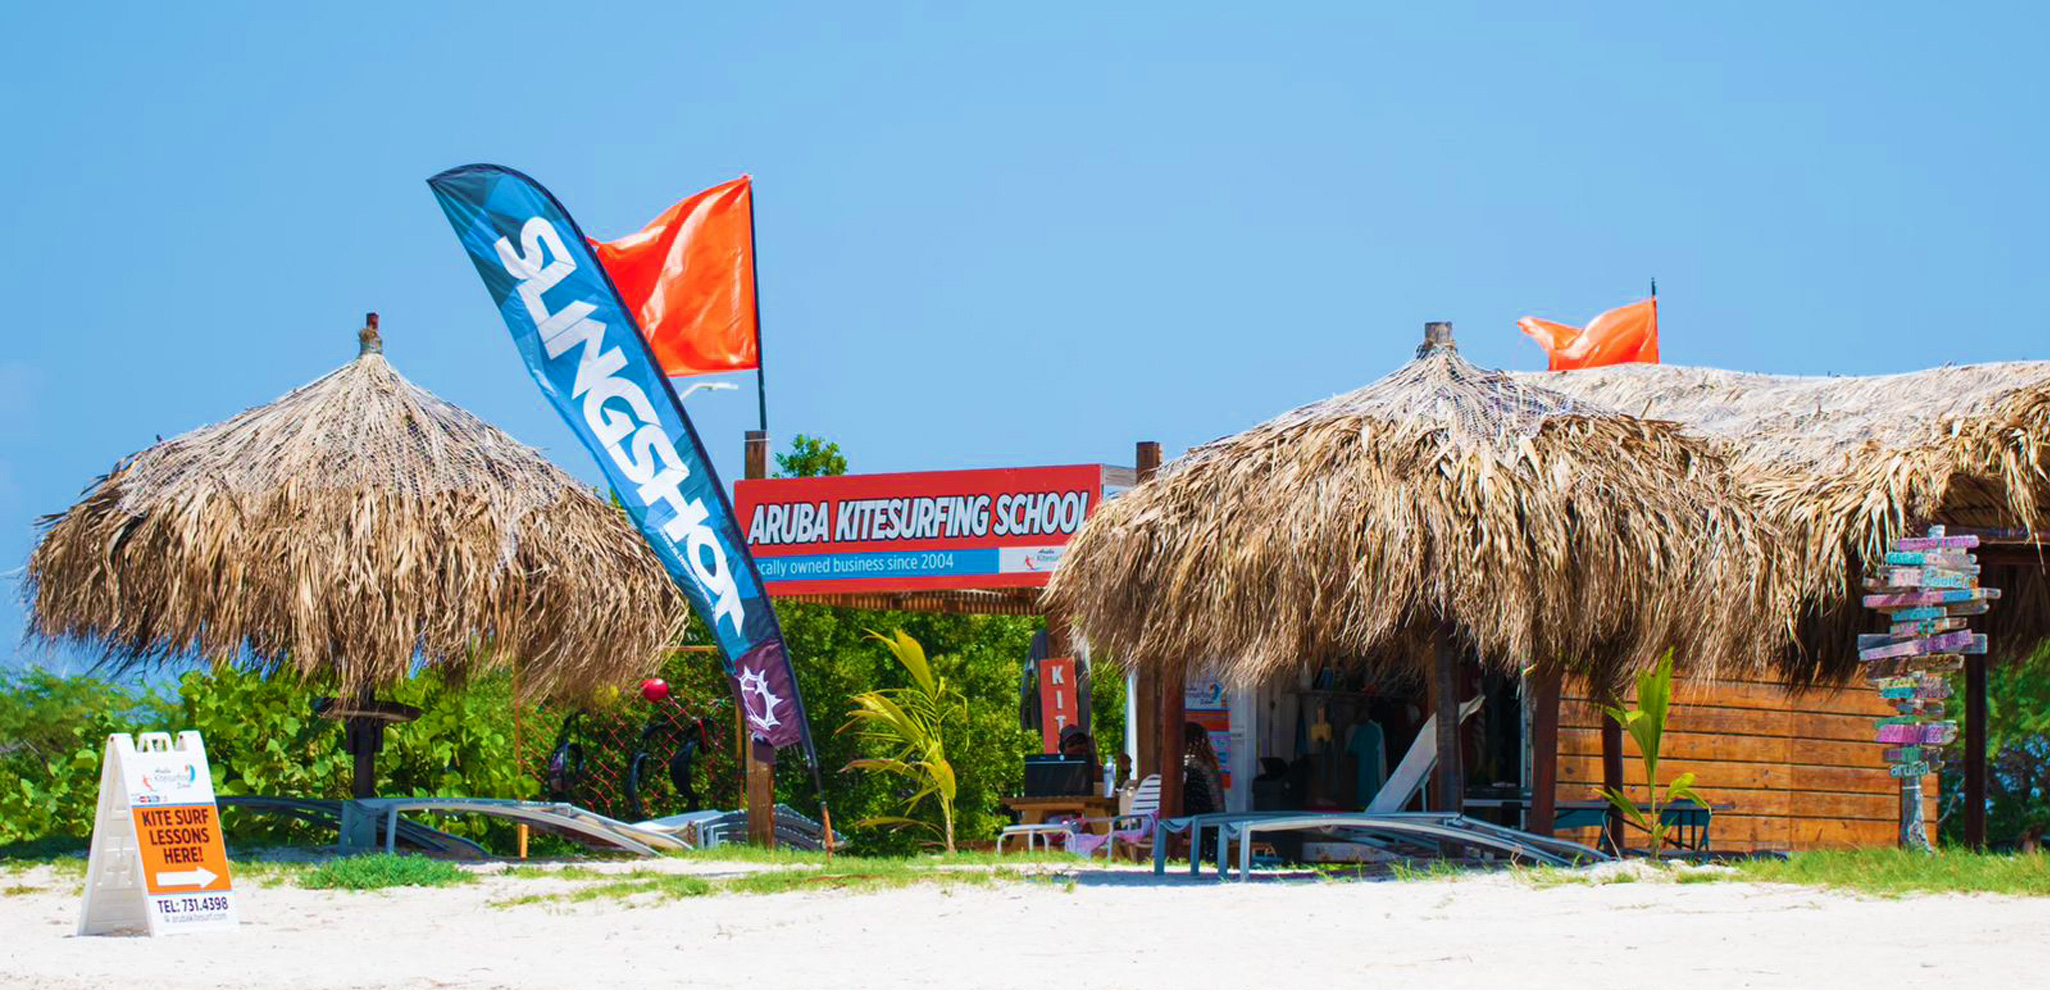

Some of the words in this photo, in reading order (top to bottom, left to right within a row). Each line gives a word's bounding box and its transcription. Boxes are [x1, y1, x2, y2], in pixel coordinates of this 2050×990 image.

[494, 216, 745, 638] SLINGSHOT
[747, 501, 829, 546] ARUBA
[834, 494, 991, 542] KITESURFING
[993, 490, 1090, 536] SCHOOL
[757, 559, 787, 577] cally
[790, 558, 831, 574] owned
[833, 556, 884, 571] business
[887, 553, 918, 570] since
[921, 553, 954, 569] 2004
[142, 810, 173, 827] KITE
[174, 808, 208, 825] SURF
[149, 827, 210, 846] LESSONS
[163, 846, 204, 865] HERE!
[157, 899, 181, 914] TEL:
[181, 896, 229, 912] 731.4398
